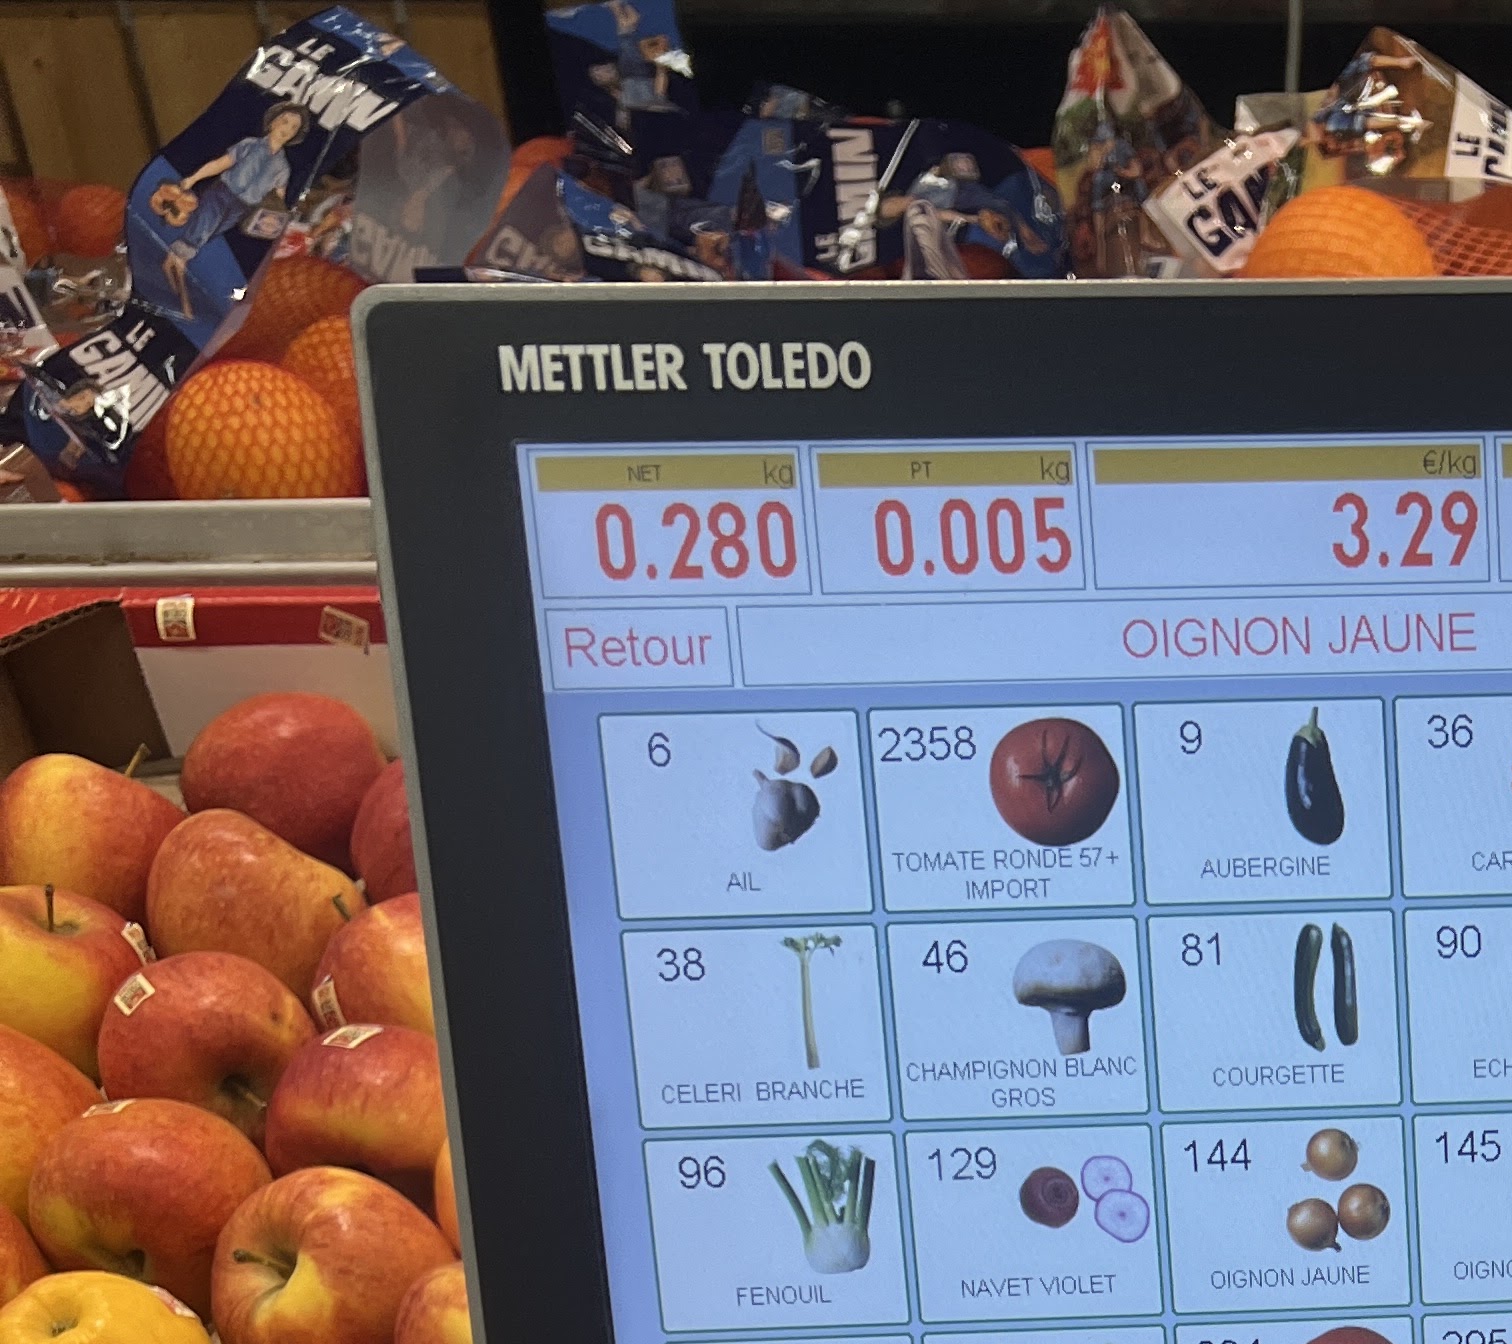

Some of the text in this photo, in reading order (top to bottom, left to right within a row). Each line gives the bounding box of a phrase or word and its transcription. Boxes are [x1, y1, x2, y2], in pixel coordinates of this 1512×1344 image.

[499, 341, 872, 391] METTLER TOLEDO
[627, 461, 796, 487] NET kg
[910, 457, 1070, 485] PT kg
[1422, 450, 1478, 478] €/kg
[595, 501, 798, 579] 0.280
[875, 497, 1072, 576] 0.005
[1332, 490, 1479, 568] 3.29
[564, 627, 712, 667] Retour
[1122, 612, 1478, 659] OIGNON JAUNE
[878, 726, 977, 763] 2358
[1180, 721, 1203, 755] 9
[1427, 714, 1474, 749] 36
[647, 732, 671, 767] 6
[893, 847, 1120, 872] TOMATE RONDE 57+
[1201, 855, 1331, 880] AUBERGINE
[727, 871, 761, 892] AIL
[964, 877, 1051, 900] IMPORT
[923, 940, 969, 974] 46
[1182, 933, 1223, 966] 81
[1436, 925, 1482, 959] 90
[657, 948, 706, 982] 38
[906, 1056, 1137, 1083] CHAMPIGNON BLANC
[1212, 1063, 1345, 1087] COURGETTE
[662, 1079, 865, 1104] CELERI BRANCHE
[991, 1087, 1056, 1109] GROS
[928, 1146, 997, 1181] 129
[1184, 1139, 1252, 1172] 144
[1435, 1130, 1501, 1164] 145
[678, 1155, 726, 1189] 96
[960, 1274, 1116, 1298] NAVET VIOLET
[1211, 1265, 1371, 1290] OIGNON JAUNE
[736, 1285, 832, 1307] FENOUIL
